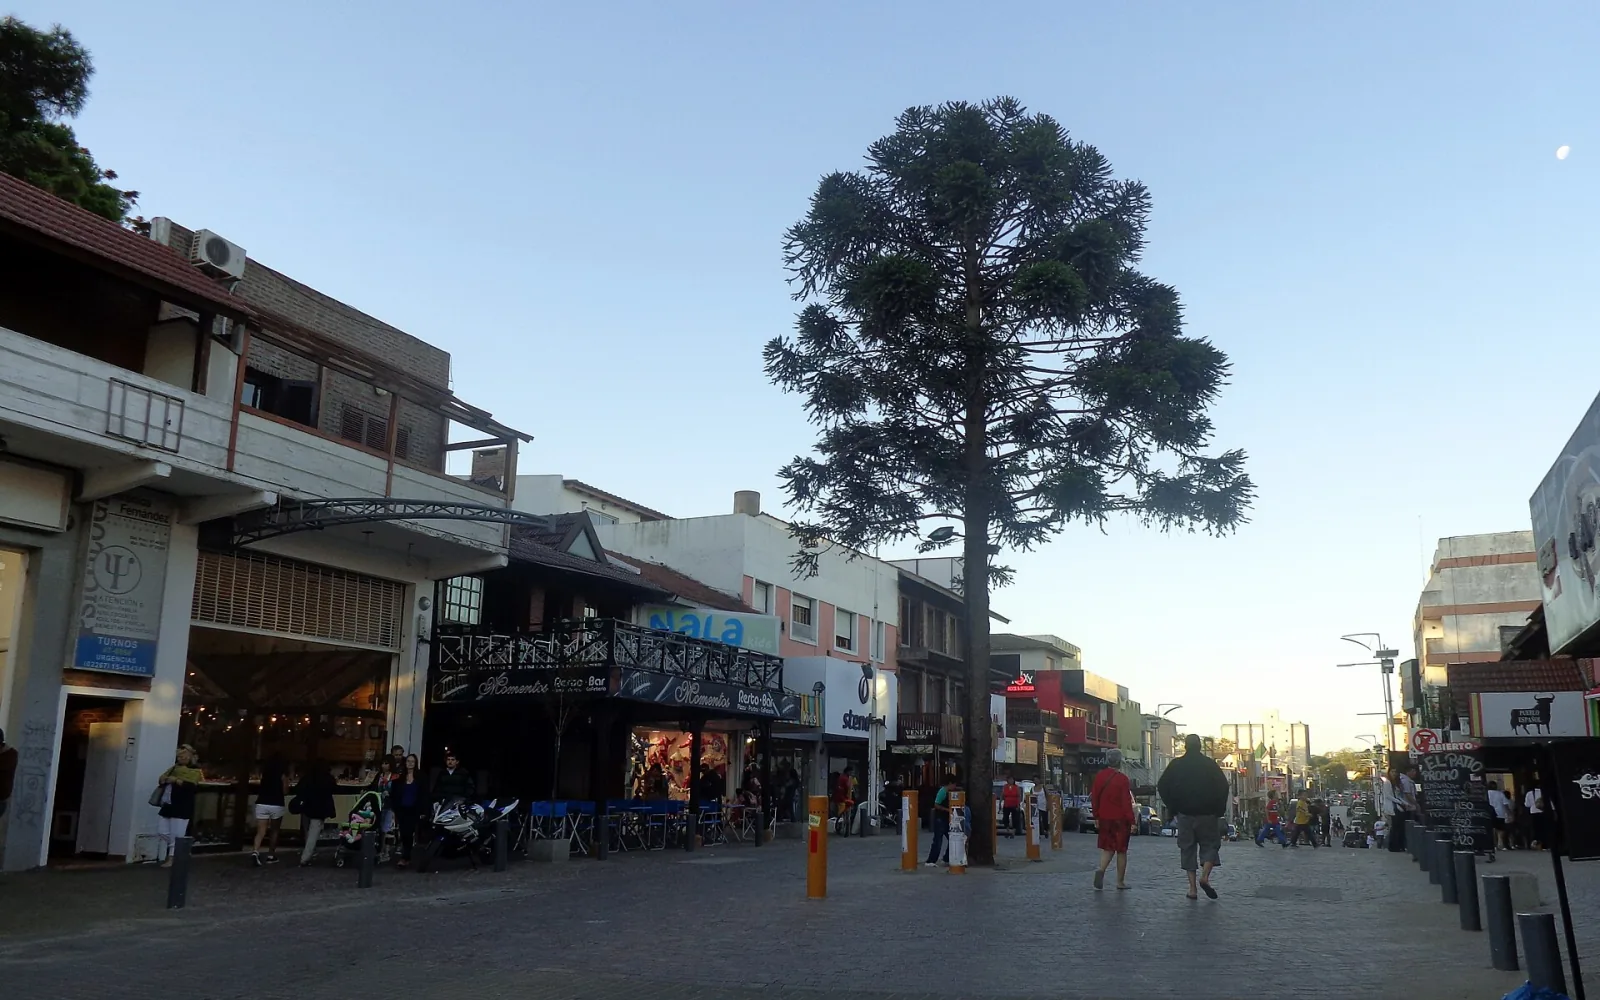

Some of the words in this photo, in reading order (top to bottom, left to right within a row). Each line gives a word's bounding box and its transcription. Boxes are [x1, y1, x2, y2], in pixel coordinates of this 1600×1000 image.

[97, 636, 139, 649] TURNOS
[95, 654, 137, 664] URGENCIAS
[588, 675, 606, 687] Bar
[674, 679, 731, 708] Momentos
[738, 689, 759, 705] Resto
[762, 693, 774, 708] Bar
[1518, 715, 1541, 723] ESPAÑOL
[1428, 742, 1473, 751] ABIERTO
[1424, 755, 1447, 770] EL
[1445, 752, 1483, 772] PATIO
[1421, 768, 1459, 781] PROMO
